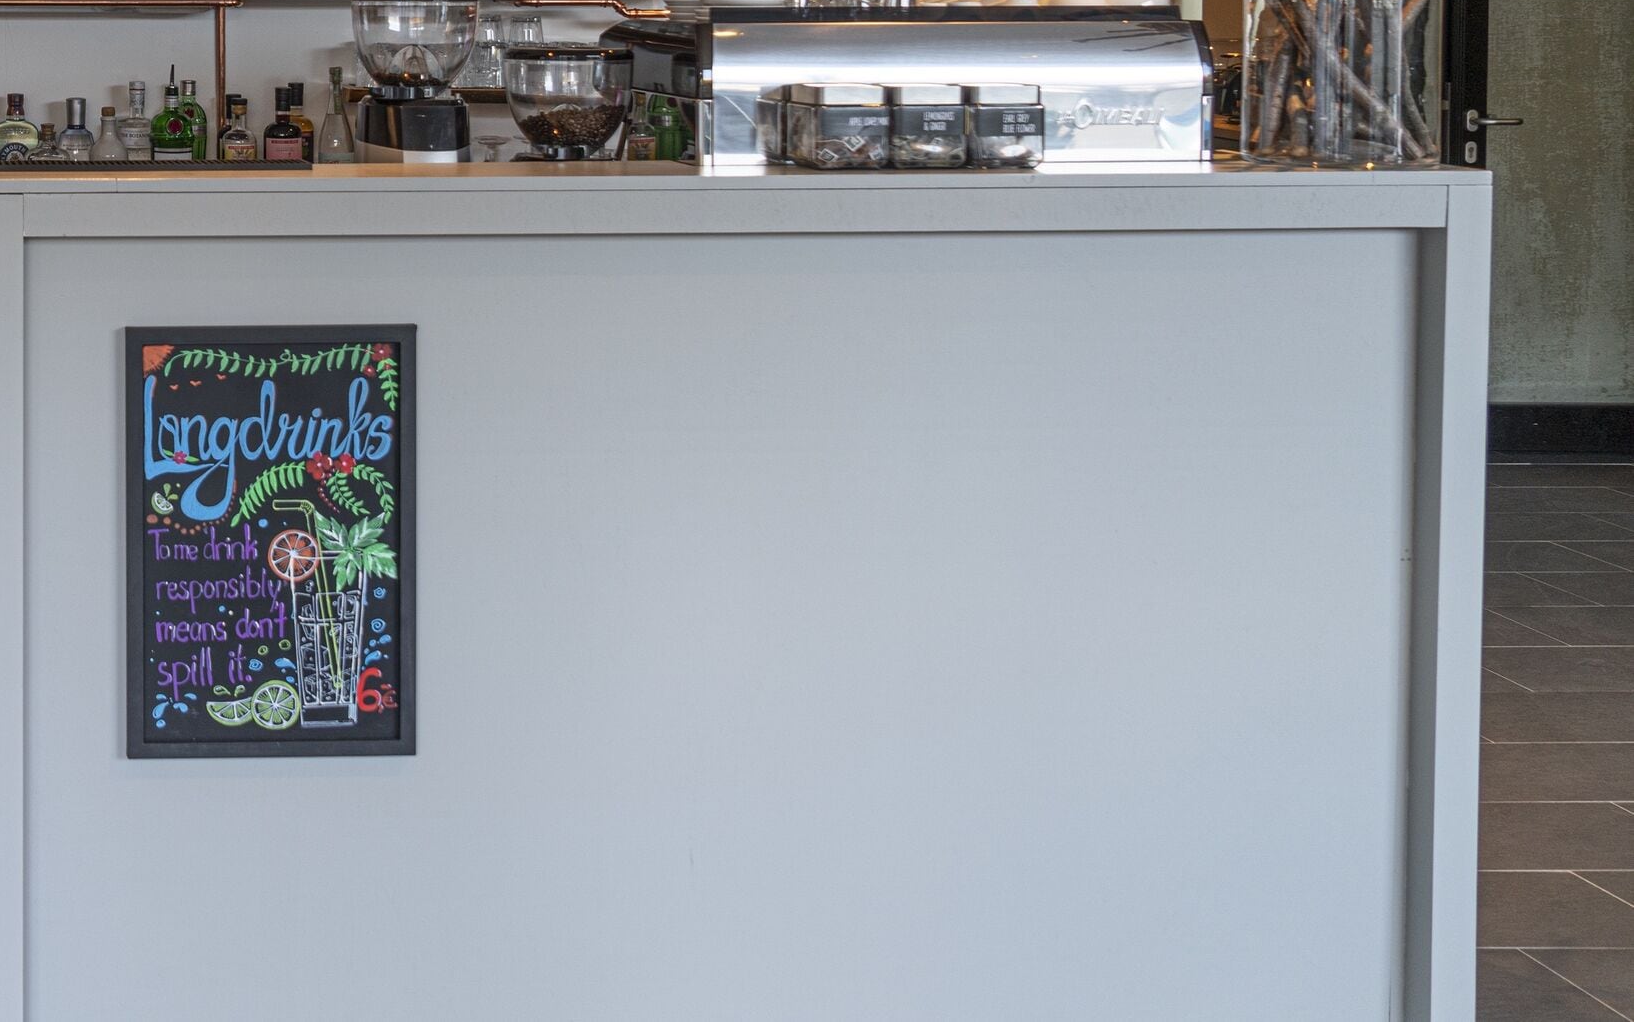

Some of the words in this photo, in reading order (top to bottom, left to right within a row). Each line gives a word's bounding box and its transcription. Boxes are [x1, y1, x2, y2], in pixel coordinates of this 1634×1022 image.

[143, 374, 393, 520] Longdrinks
[147, 528, 170, 560] To
[173, 544, 198, 561] me
[203, 523, 258, 561] drink
[155, 564, 284, 615] responsibly
[155, 620, 227, 642] means
[235, 601, 288, 639] don't
[156, 646, 214, 702] spill
